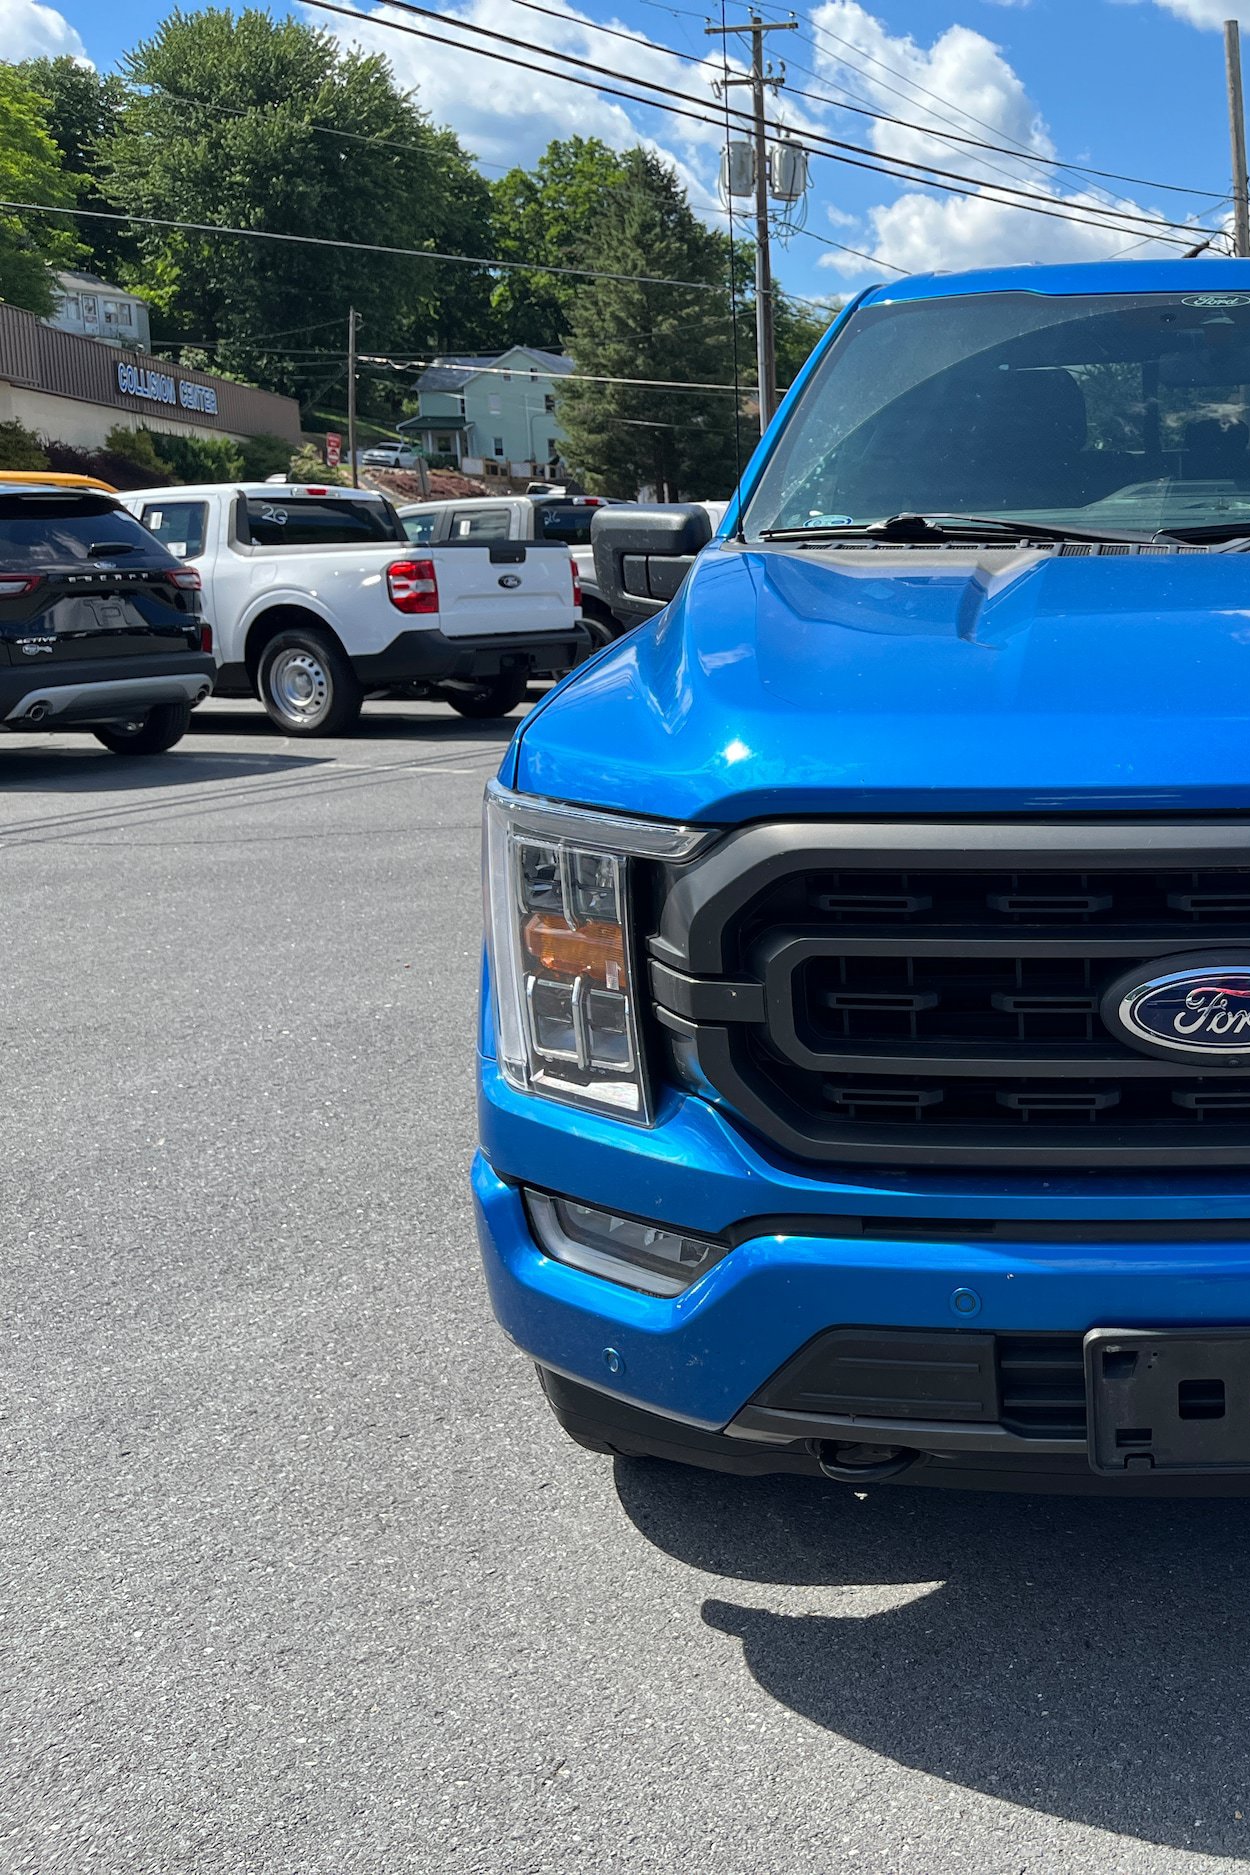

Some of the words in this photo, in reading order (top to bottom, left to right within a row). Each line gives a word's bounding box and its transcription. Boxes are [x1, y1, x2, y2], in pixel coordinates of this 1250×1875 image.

[1193, 295, 1240, 306] Ford
[118, 362, 177, 405] COLLISION
[179, 380, 218, 415] CENTER
